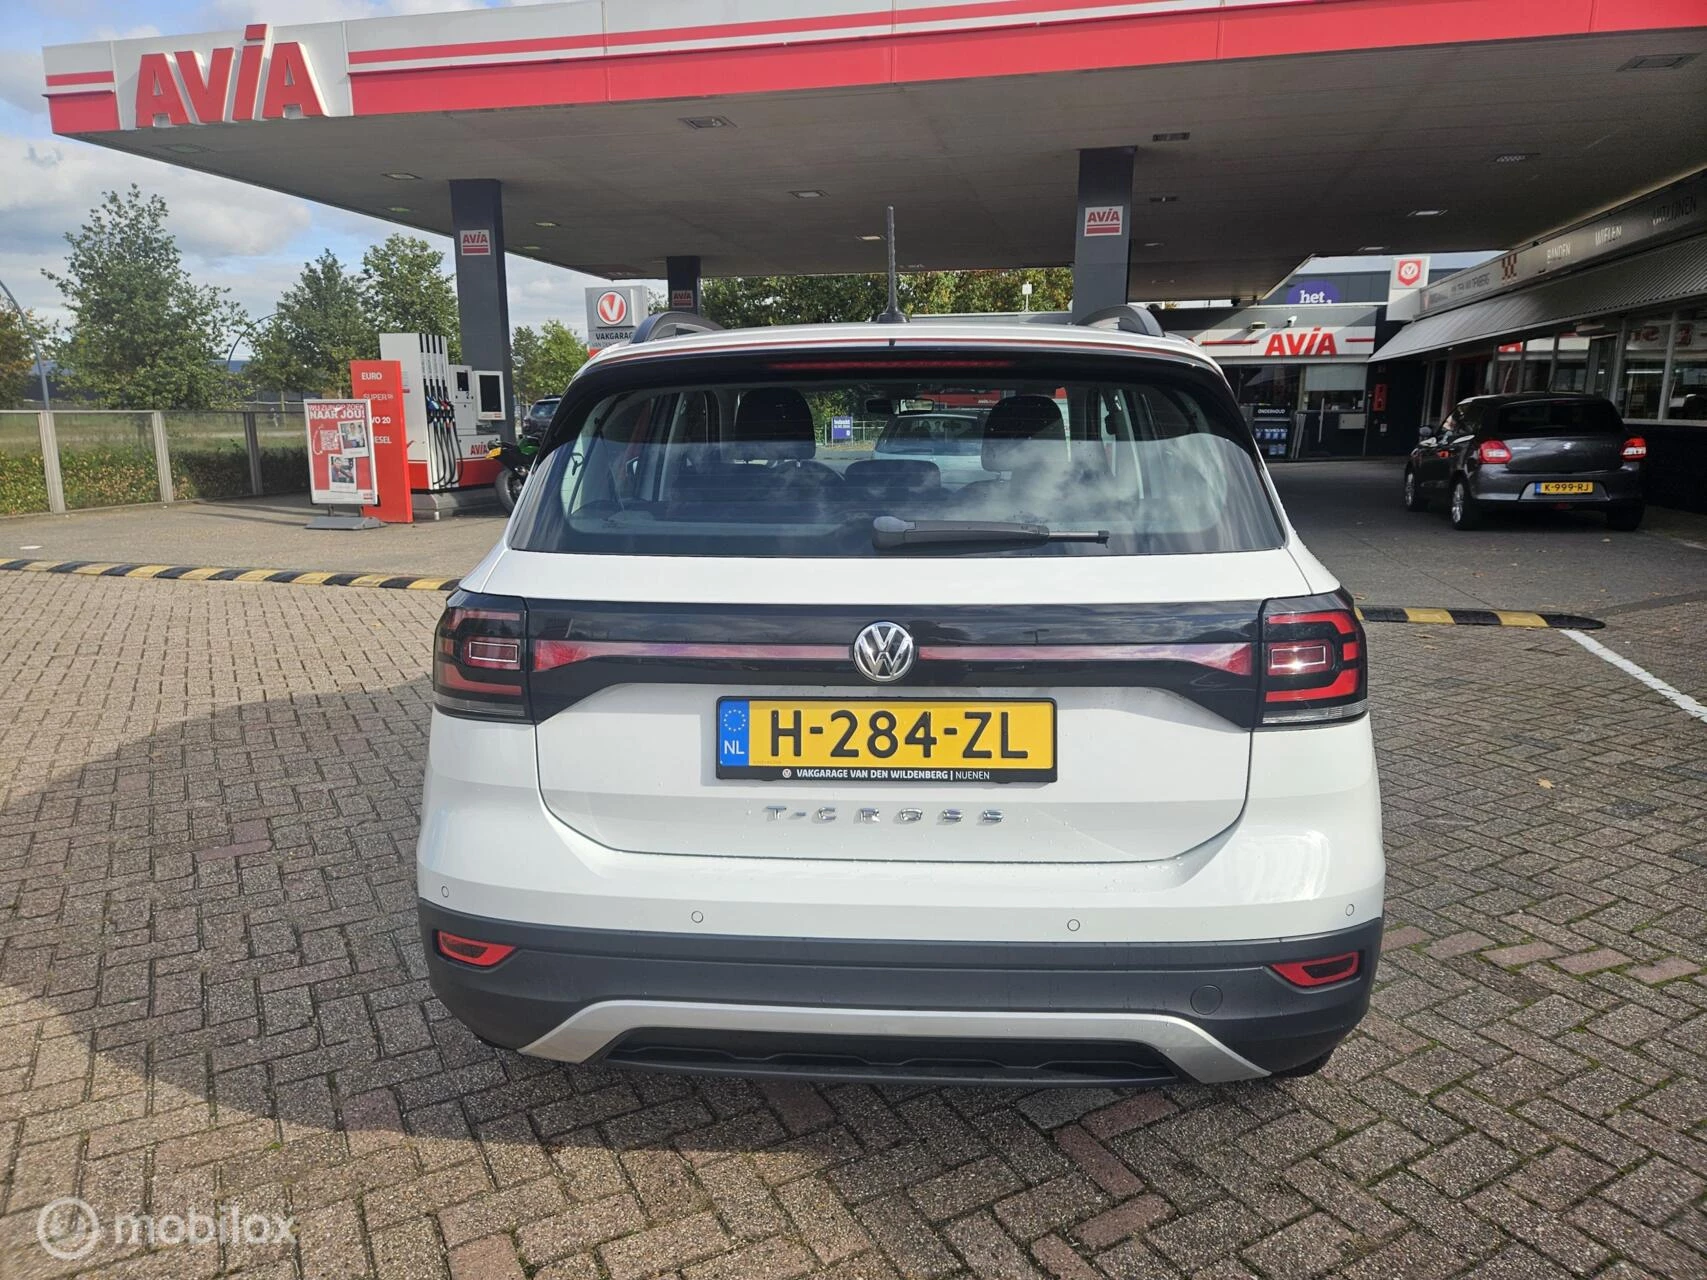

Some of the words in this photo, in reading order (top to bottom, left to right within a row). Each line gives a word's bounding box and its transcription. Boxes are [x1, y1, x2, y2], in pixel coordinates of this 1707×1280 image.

[1087, 208, 1121, 223] AVIA
[463, 232, 488, 244] AVIA
[1264, 327, 1338, 358] AVIA
[361, 372, 382, 380] EURO
[363, 393, 387, 401] SUPER
[309, 410, 338, 420] NAAR
[340, 409, 365, 419] JOU!
[382, 416, 391, 424] 20
[470, 441, 490, 456] AVIA
[1544, 483, 1590, 492] K-999-RJ
[724, 742, 745, 756] NL
[770, 709, 1029, 759] H-284-ZL
[796, 768, 848, 778] VAKGARAGE
[850, 769, 868, 778] VAN
[870, 769, 888, 779] DEN
[890, 770, 948, 779] WILDENBERG
[955, 770, 990, 780] NUENEN
[764, 804, 1004, 823] T-CROSS
